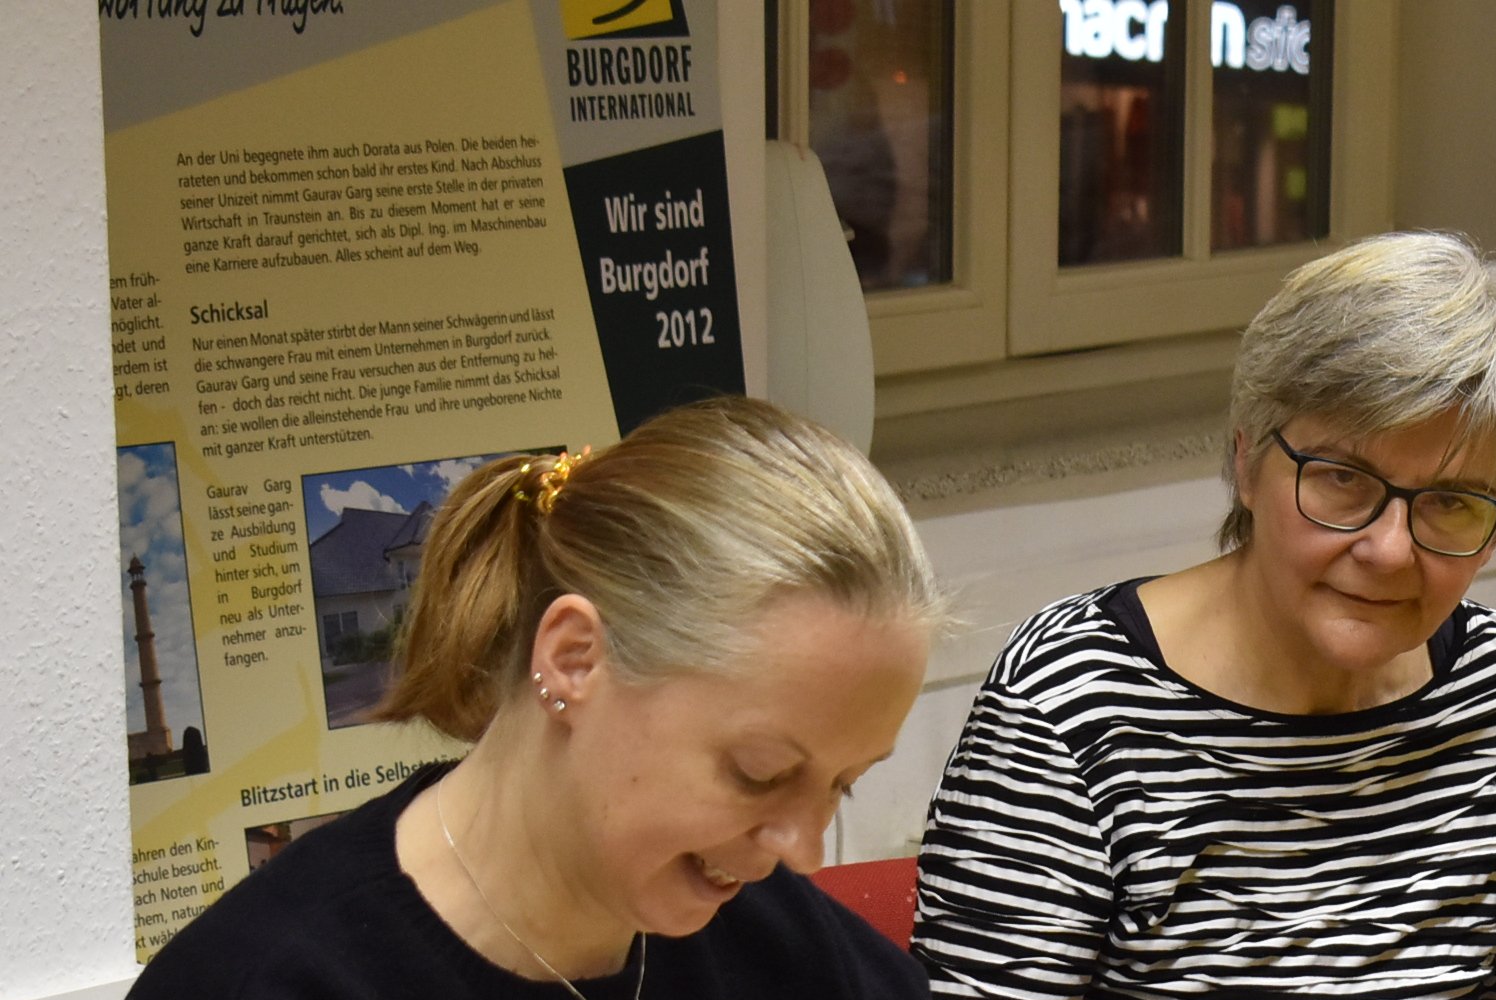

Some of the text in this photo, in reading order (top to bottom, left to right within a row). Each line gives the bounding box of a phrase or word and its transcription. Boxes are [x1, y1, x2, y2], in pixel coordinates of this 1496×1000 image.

[566, 44, 692, 87] BURGDORF
[570, 92, 696, 122] INTERNATIONAL
[176, 133, 540, 167] An der Uni begegnete ihm auch Dorata aus Polen. Die beiden hei-
[178, 155, 542, 188] rateten und bekommen schon bald ihr erstes Kind. Nach Abschluss
[180, 175, 544, 210] seiner Unizeit nimmt Gaurav Garg seine erste Stelle in der privaten
[182, 194, 545, 230] Wirtschaft in Traunstein an. Bis zu diesem Moment hat er seine
[604, 188, 705, 234] Wir sind
[184, 214, 547, 256] ganze Kraft darauf gerichtet, sich als Dipl. Ing. im Maschinenbau
[185, 240, 483, 274] eine Karriere aufzubauen. Alles scheint auf dem Weg.
[600, 247, 709, 301] Burgdorf
[190, 299, 269, 325] Schicksal
[656, 307, 715, 349] 2012
[206, 479, 292, 499] Gaurav Garg
[211, 520, 296, 542] ze Ausbildung
[213, 540, 298, 562] und Studium
[215, 562, 301, 583] hinter sich, um
[217, 580, 302, 604] in Burgdorf
[220, 603, 304, 624] neu als Unter-
[224, 651, 269, 668] fangen.
[240, 780, 320, 807] Blitzstart
[324, 774, 339, 793] in
[345, 769, 370, 789] die
